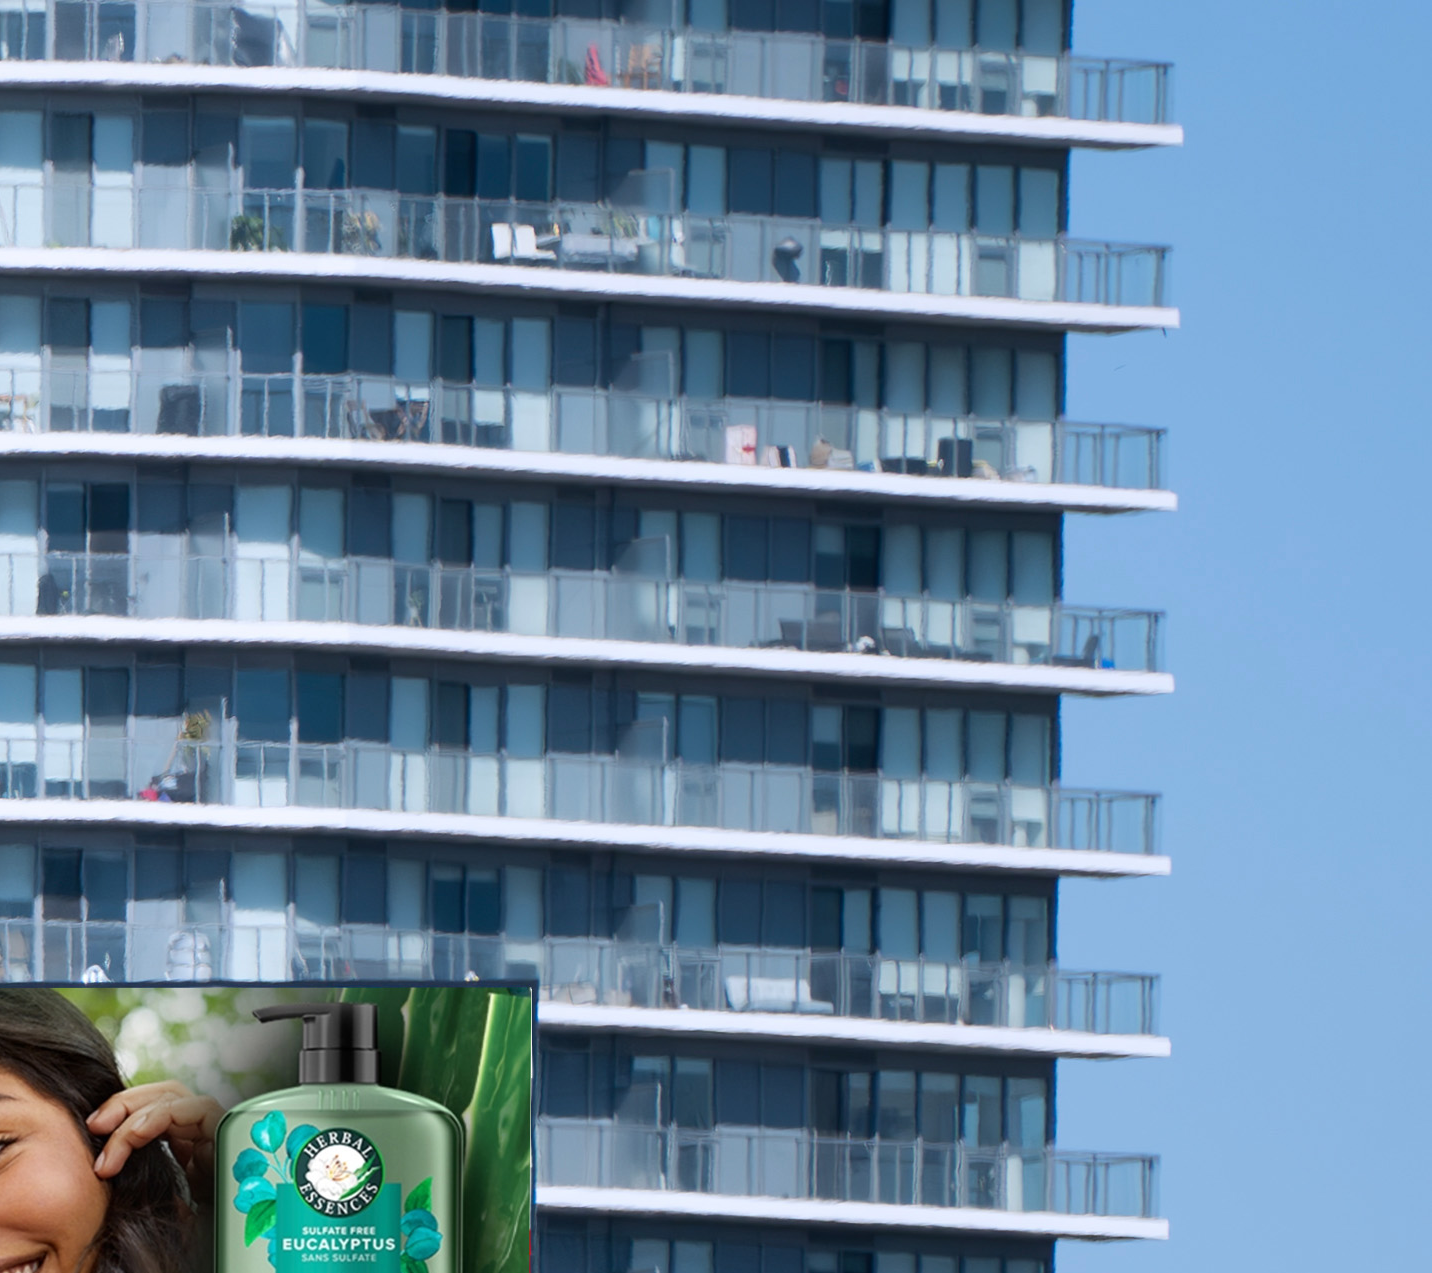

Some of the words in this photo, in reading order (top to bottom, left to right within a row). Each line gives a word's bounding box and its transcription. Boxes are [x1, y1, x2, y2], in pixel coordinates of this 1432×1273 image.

[303, 1131, 373, 1159] HERBAL
[299, 1183, 379, 1216] ESSENCES
[302, 1226, 347, 1235] SULFATE
[350, 1226, 376, 1235] FREE
[282, 1238, 396, 1251] EUCALYPTUS
[301, 1253, 329, 1262] SANS
[332, 1253, 377, 1262] SULFATE
